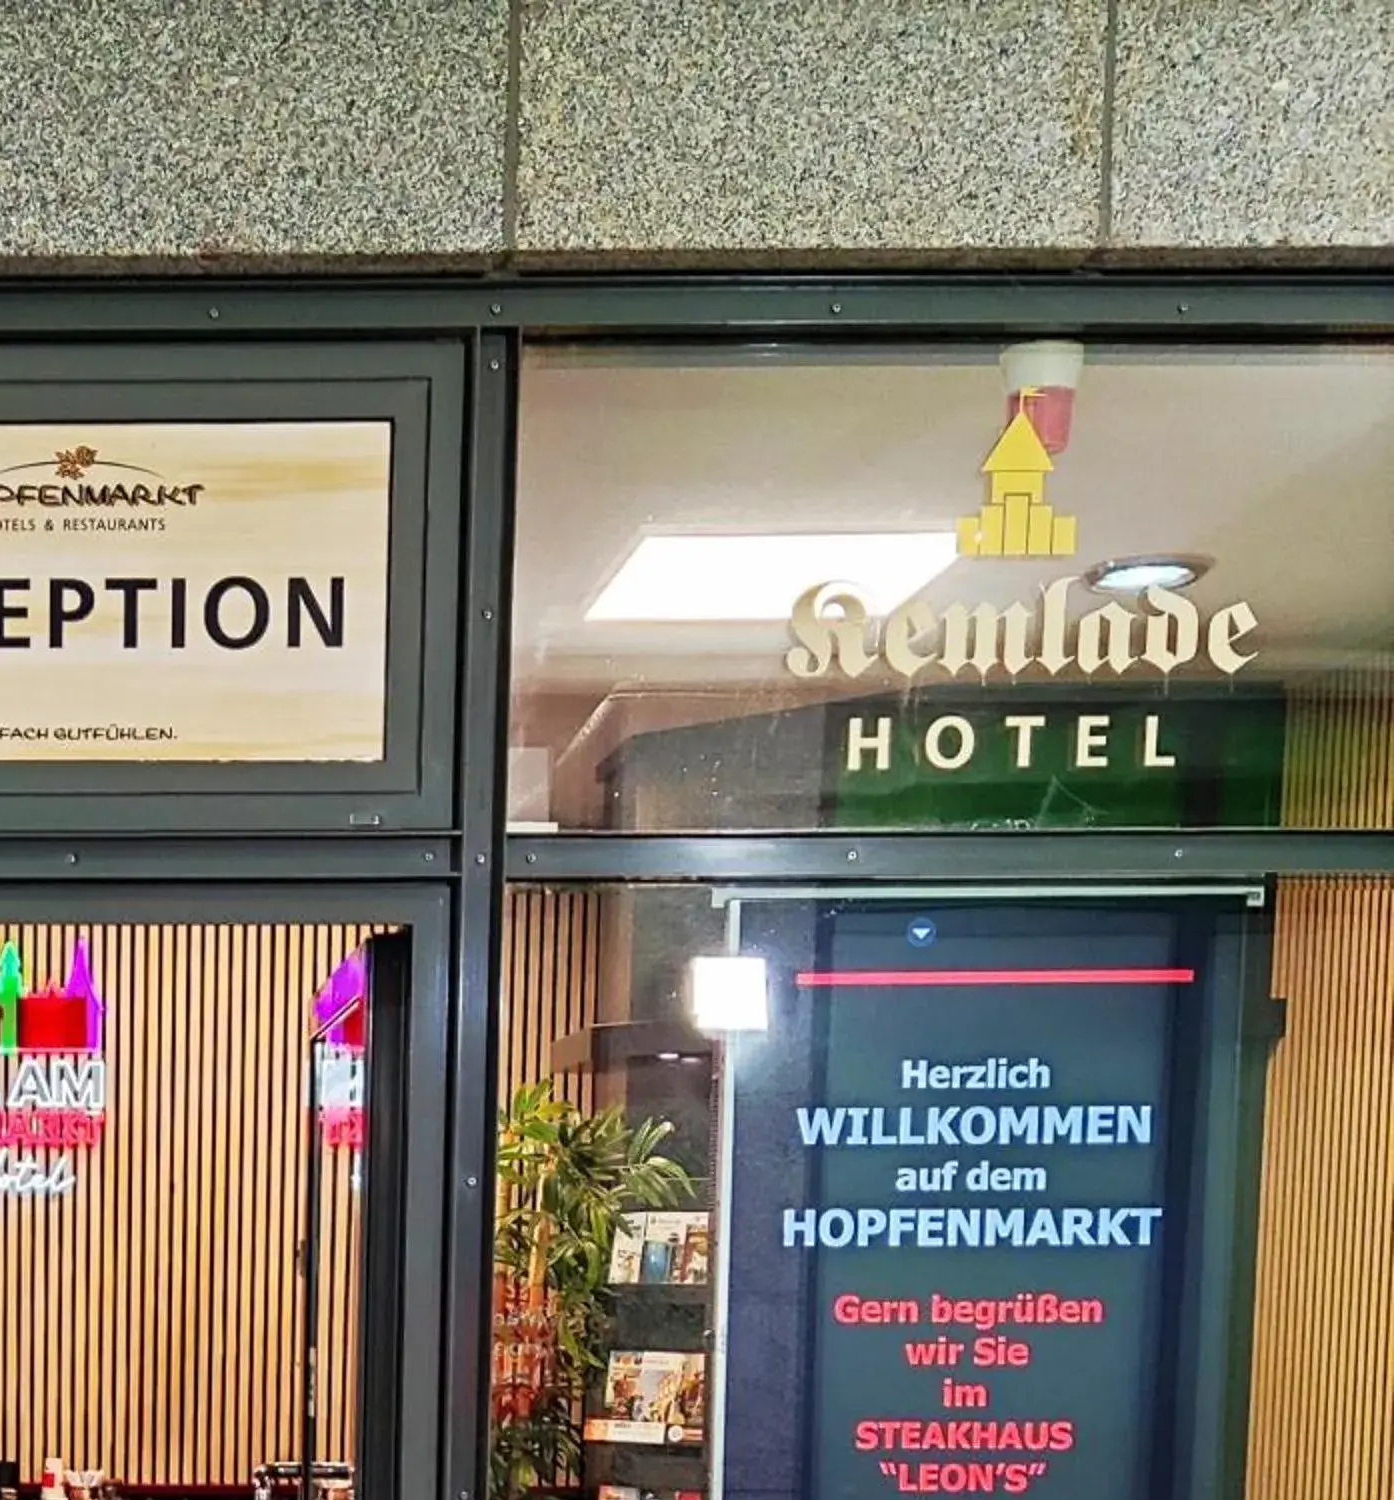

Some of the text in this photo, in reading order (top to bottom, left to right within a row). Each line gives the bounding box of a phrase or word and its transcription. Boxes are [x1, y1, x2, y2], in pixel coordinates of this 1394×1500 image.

[44, 519, 54, 531] &
[63, 518, 166, 531] RESTAURANTS
[847, 714, 1177, 772] HOTEL
[10, 1059, 106, 1111] AM
[901, 1059, 1050, 1091] Herzlich
[797, 1105, 1152, 1146] WILLKOMMEN
[895, 1161, 1046, 1192] auf dem
[782, 1208, 1162, 1248] HOPFENMARKT
[834, 1294, 1103, 1332] Gern begrüßen
[906, 1337, 1029, 1367] wir Sie
[942, 1380, 987, 1408] im
[855, 1422, 1073, 1450] STEAKHAUS
